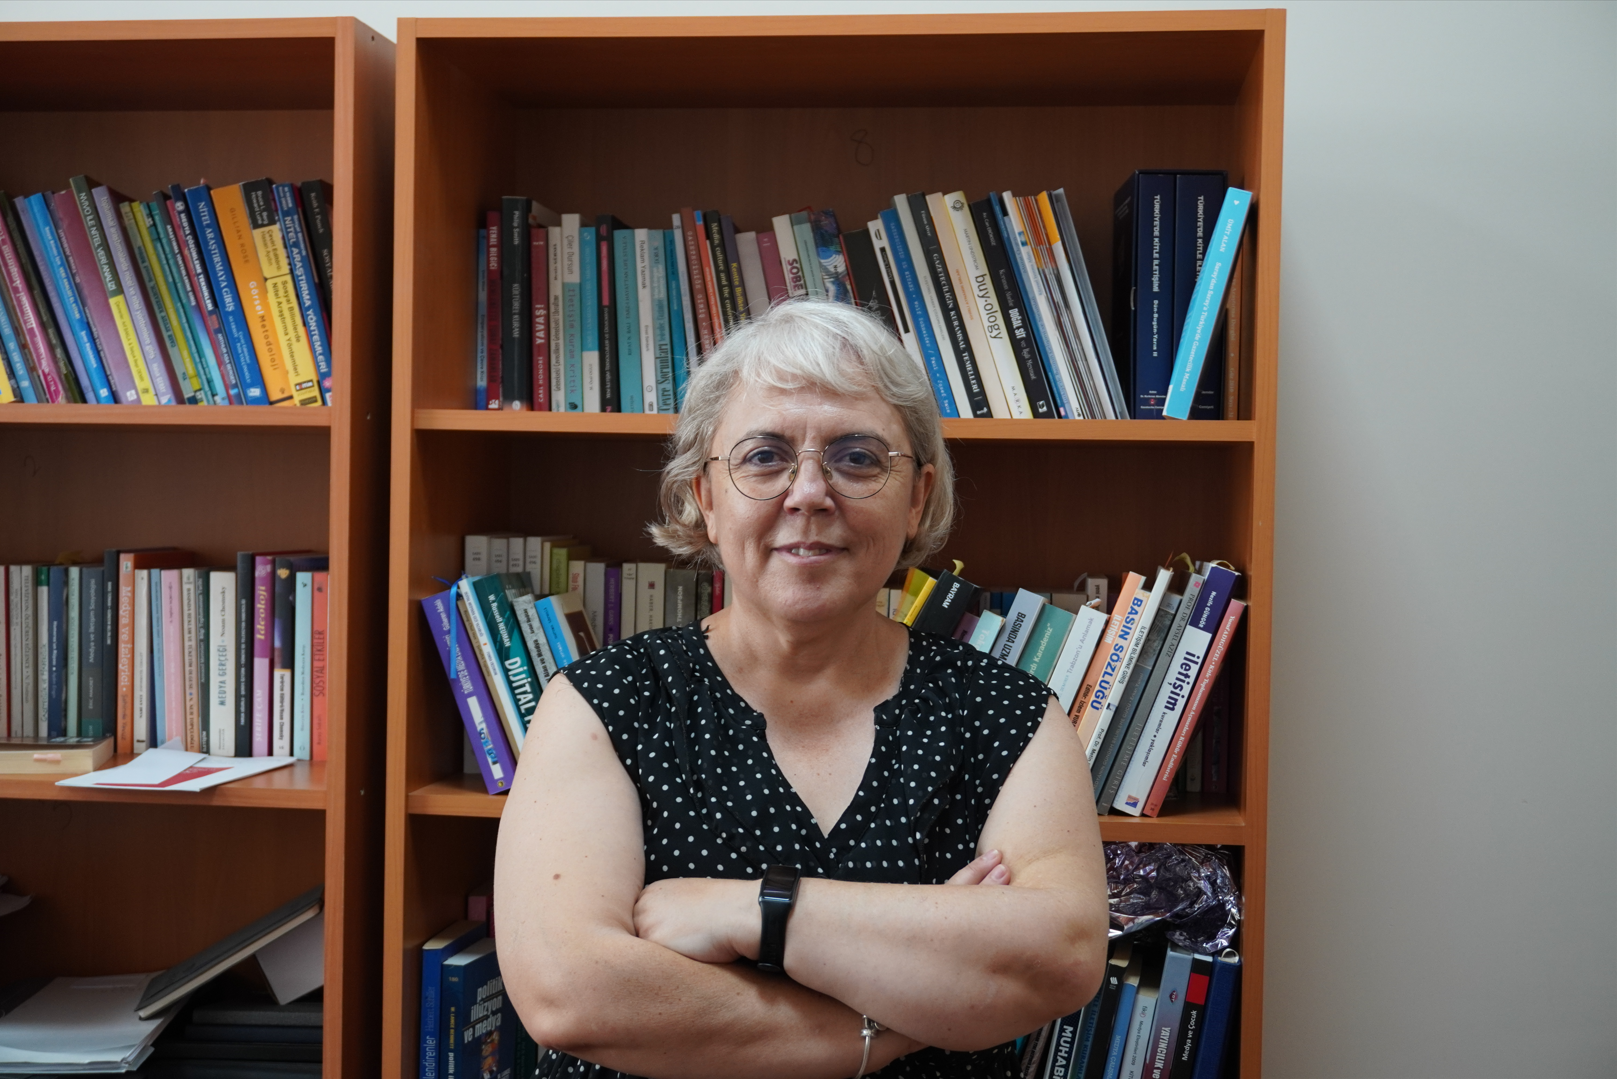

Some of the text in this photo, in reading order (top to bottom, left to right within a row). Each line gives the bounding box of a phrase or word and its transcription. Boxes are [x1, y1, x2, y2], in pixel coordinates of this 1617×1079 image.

[261, 211, 269, 225] Berg
[711, 222, 722, 245] Media,
[179, 213, 191, 235] MEDYA
[185, 235, 205, 274] ÇÖZÜMLEME
[228, 207, 251, 265] GILLIAN ROSE
[566, 235, 574, 250] Çiler
[1219, 218, 1235, 253] ÜMİT ALAN
[197, 201, 237, 312] NİTEL ARAŞTIRMAYA GİRİŞ
[716, 247, 726, 271] culture
[720, 272, 728, 285] and
[730, 262, 742, 285] Kentte
[1152, 260, 1160, 292] İLETİŞİMİ
[1208, 261, 1222, 290] Saray'dan
[129, 287, 136, 296] ve
[284, 216, 329, 372] NİTEL ARAŞTIRMA YÖNTEMLERİ
[513, 284, 521, 314] KÜLTÜREL
[248, 280, 282, 371] Görsel Metodoloji
[280, 280, 302, 343] Sosyal Bilimlerde
[535, 304, 546, 344] YAVAŞ!
[931, 253, 981, 393] GAZETECİLİĞİN KURAMSAL TEMELLERİ
[1009, 307, 1024, 328] DOĞAL
[1194, 311, 1208, 341] Türkiye'de
[272, 282, 300, 377] Nitel Araştırma Yöntemleri
[1015, 327, 1027, 339] SİT
[1185, 341, 1200, 373] Gazetecilik
[570, 364, 578, 394] Kritik
[1180, 373, 1190, 392] Masalı
[942, 582, 961, 608] BAYRAM
[488, 594, 497, 603] W.
[498, 622, 512, 647] NEUMAN
[1007, 611, 1027, 644] BASINDA
[1079, 617, 1095, 644] Anlamak
[1102, 613, 1125, 644] İLETİŞİM
[1172, 623, 1183, 642] AYSEL
[1198, 606, 1212, 629] GÜNGÖR
[120, 586, 132, 686] Medya ve İzleyici
[1165, 642, 1177, 658] AZİZ
[1213, 630, 1231, 662] ADIGÜZEL
[314, 630, 325, 697] SOSYAL ETKİLER
[1090, 596, 1144, 712] BASIN SÖZLÜĞÜ
[1118, 625, 1148, 685] İLETİŞİM BİLİMİNE GİRİŞ
[217, 645, 228, 706] MEDYA GERÇEĞİ
[504, 656, 539, 714] DİJİTAL
[1159, 649, 1202, 714] iletişim
[1096, 728, 1105, 740] Prof.
[1141, 711, 1168, 768] kuramlar yaklaşımlar
[1088, 748, 1096, 762] Metin
[471, 995, 503, 1022] illüzyon
[464, 1029, 474, 1044] ve
[475, 1013, 501, 1036] medya
[1181, 1009, 1199, 1061] Medya ve Çocuk
[1155, 1026, 1171, 1068] YAYINCILIK
